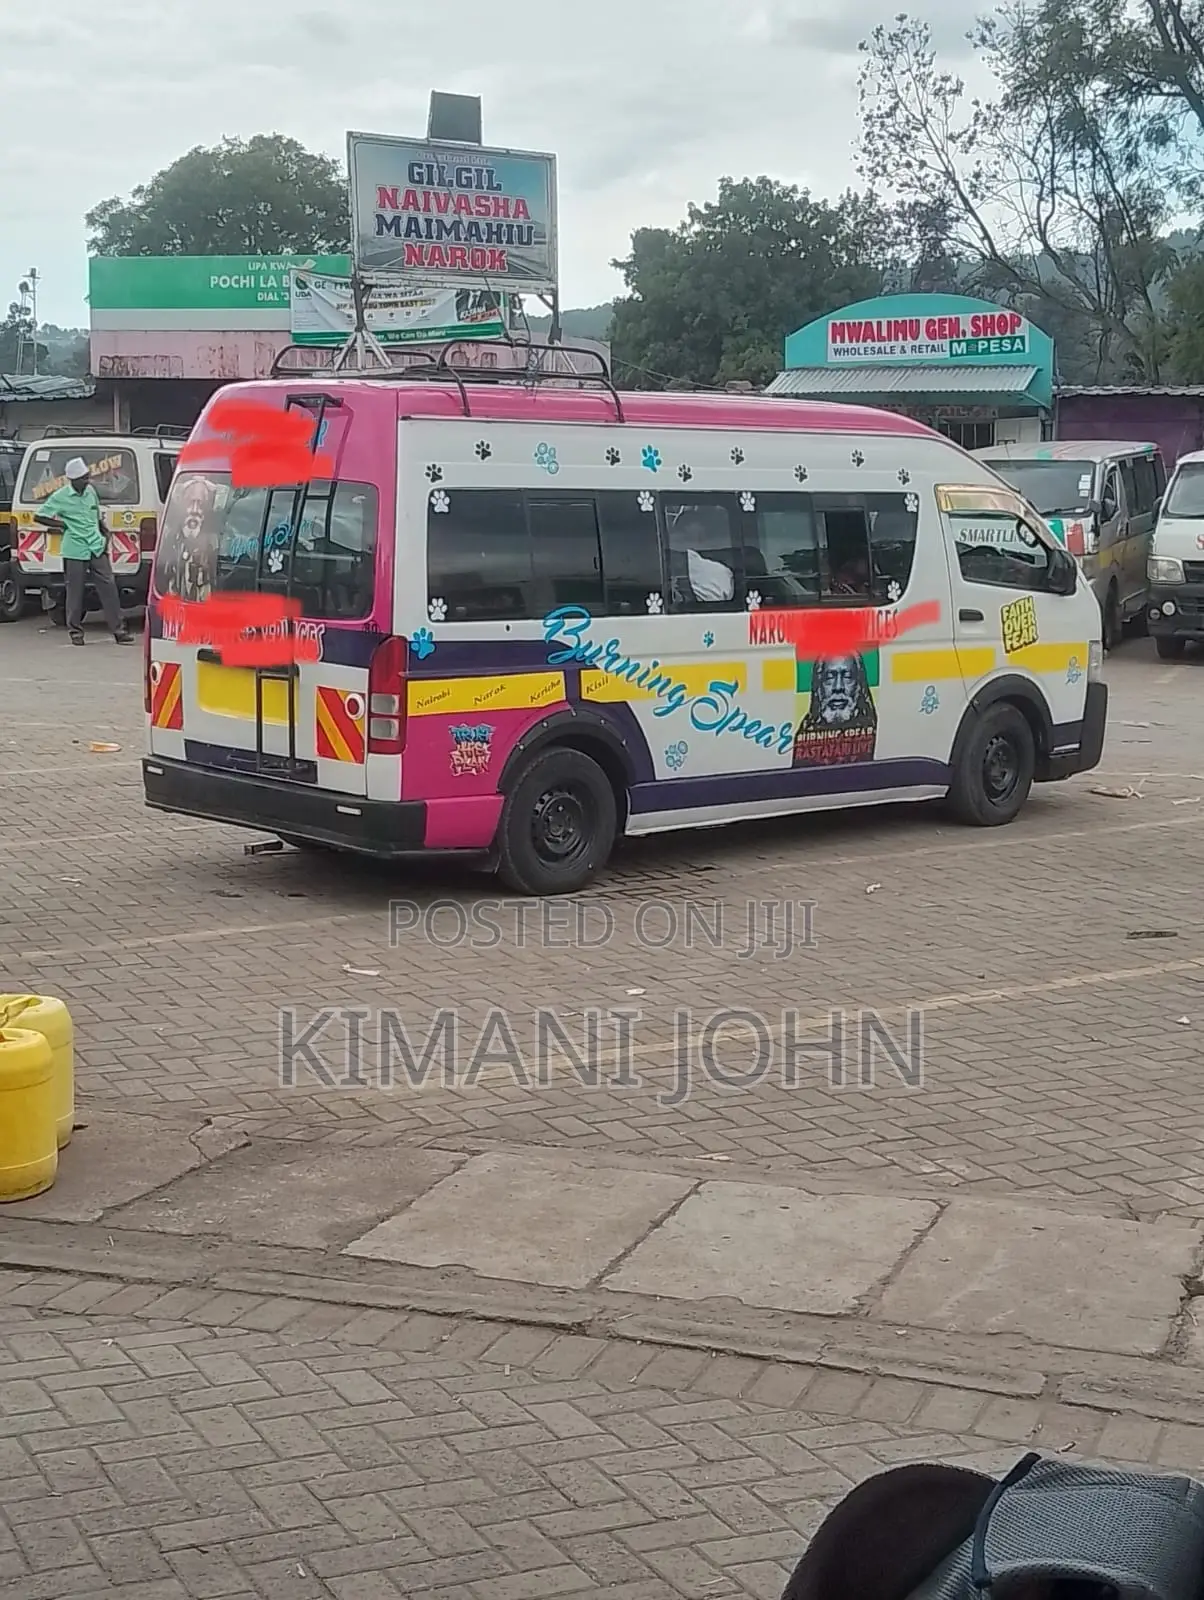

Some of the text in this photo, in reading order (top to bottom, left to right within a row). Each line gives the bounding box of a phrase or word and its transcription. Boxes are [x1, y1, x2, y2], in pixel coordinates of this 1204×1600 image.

[408, 161, 502, 192] GILGIL
[376, 186, 531, 220] NAIVASHA
[375, 213, 534, 246] MAIMAHIU
[404, 242, 508, 272] NAROK
[210, 275, 255, 289] POCHI
[260, 275, 278, 288] LA
[257, 292, 279, 302] DIAL
[831, 313, 1022, 344] MWALIMU GEN. SHOP
[833, 343, 947, 356] WHOLESALE & RETAIL
[1002, 596, 1033, 622] FAITH
[1004, 611, 1036, 635] OVER
[1005, 625, 1038, 652] FEAR
[542, 604, 797, 755] Burning Spear
[416, 688, 451, 709] Nairobi
[473, 684, 507, 705] Narok
